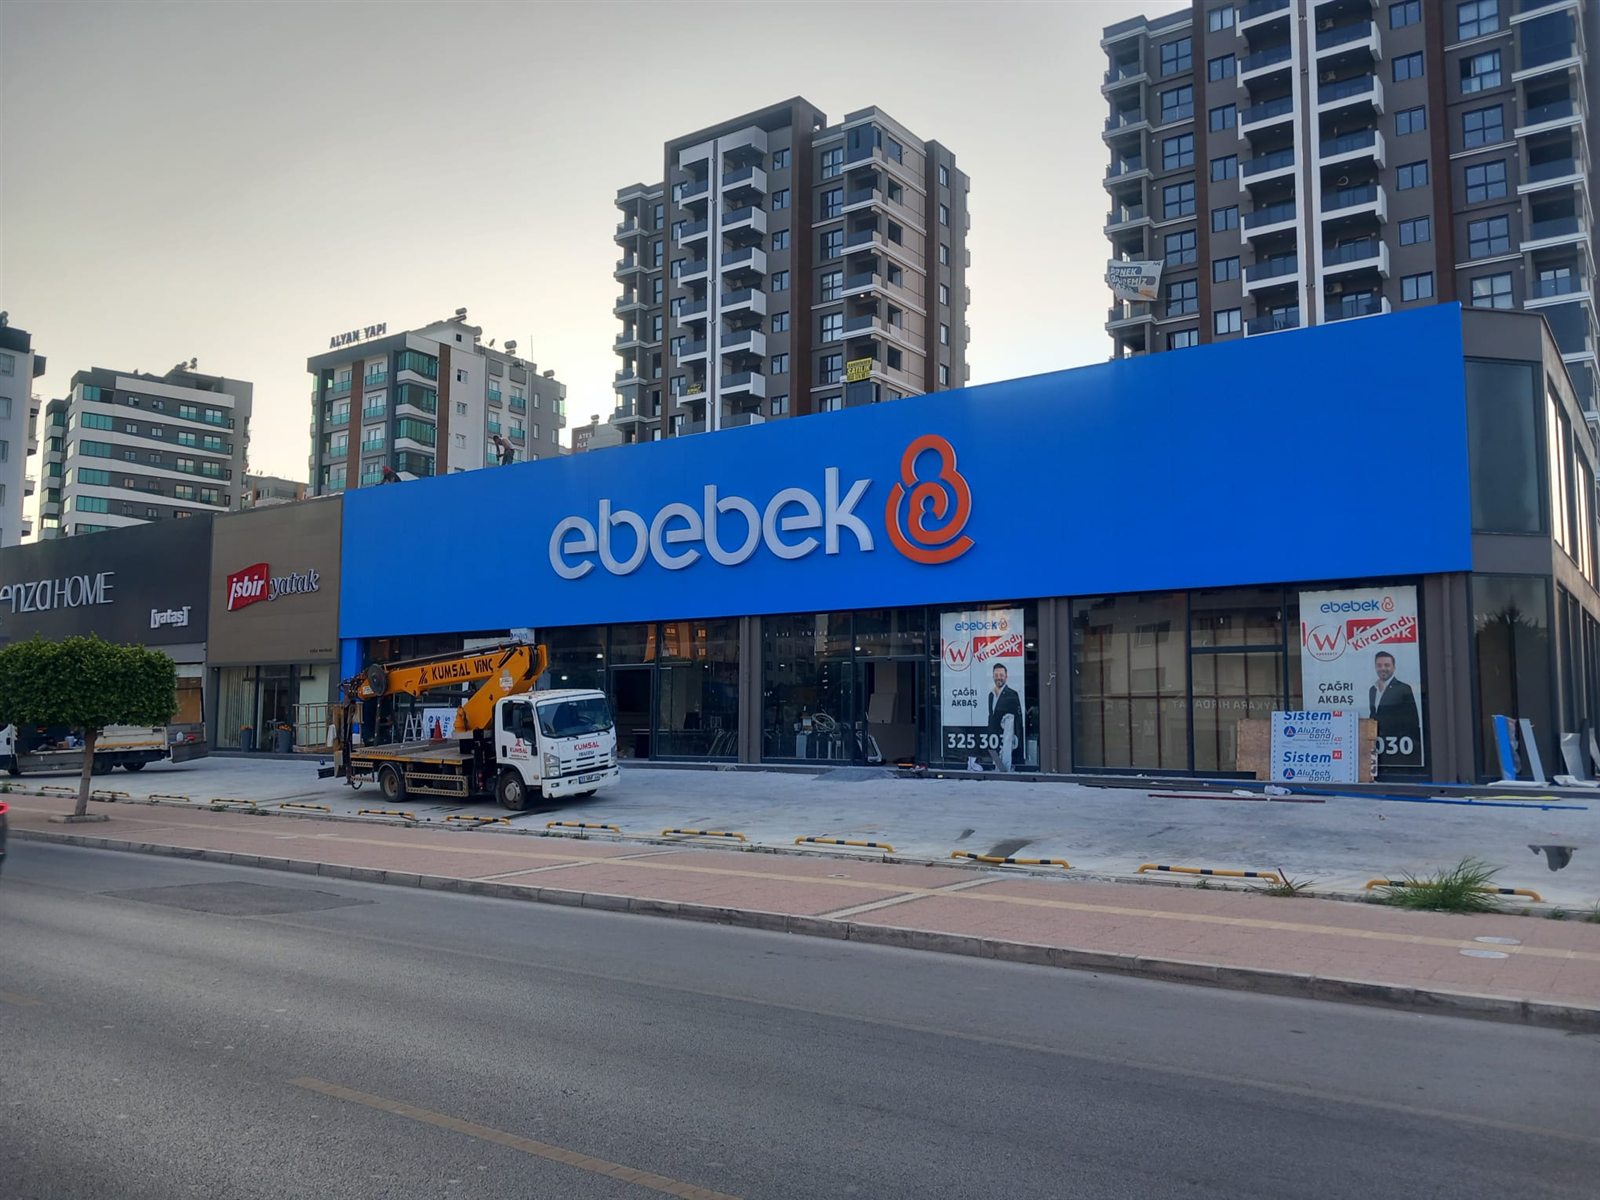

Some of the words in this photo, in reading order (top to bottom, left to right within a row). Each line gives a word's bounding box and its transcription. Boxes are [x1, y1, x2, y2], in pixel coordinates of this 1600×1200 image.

[330, 330, 360, 348] ALYAN
[364, 322, 387, 339] YAPI
[549, 467, 874, 579] ebebek
[54, 571, 115, 608] HOME
[268, 568, 320, 601] yatak
[1320, 599, 1380, 614] ebebek
[954, 620, 998, 631] ebebek
[431, 662, 471, 680] KUMSAL
[952, 687, 977, 697] ÇAĞRI
[1318, 681, 1353, 692] ÇAĞRI
[951, 699, 978, 709] AKBAŞ
[1318, 694, 1354, 705] AKBAŞ
[1283, 711, 1332, 721] Sistem
[573, 741, 600, 751] KUMSAL
[947, 733, 976, 749] 325
[1375, 736, 1413, 755] 030
[1283, 751, 1331, 763] Sistem
